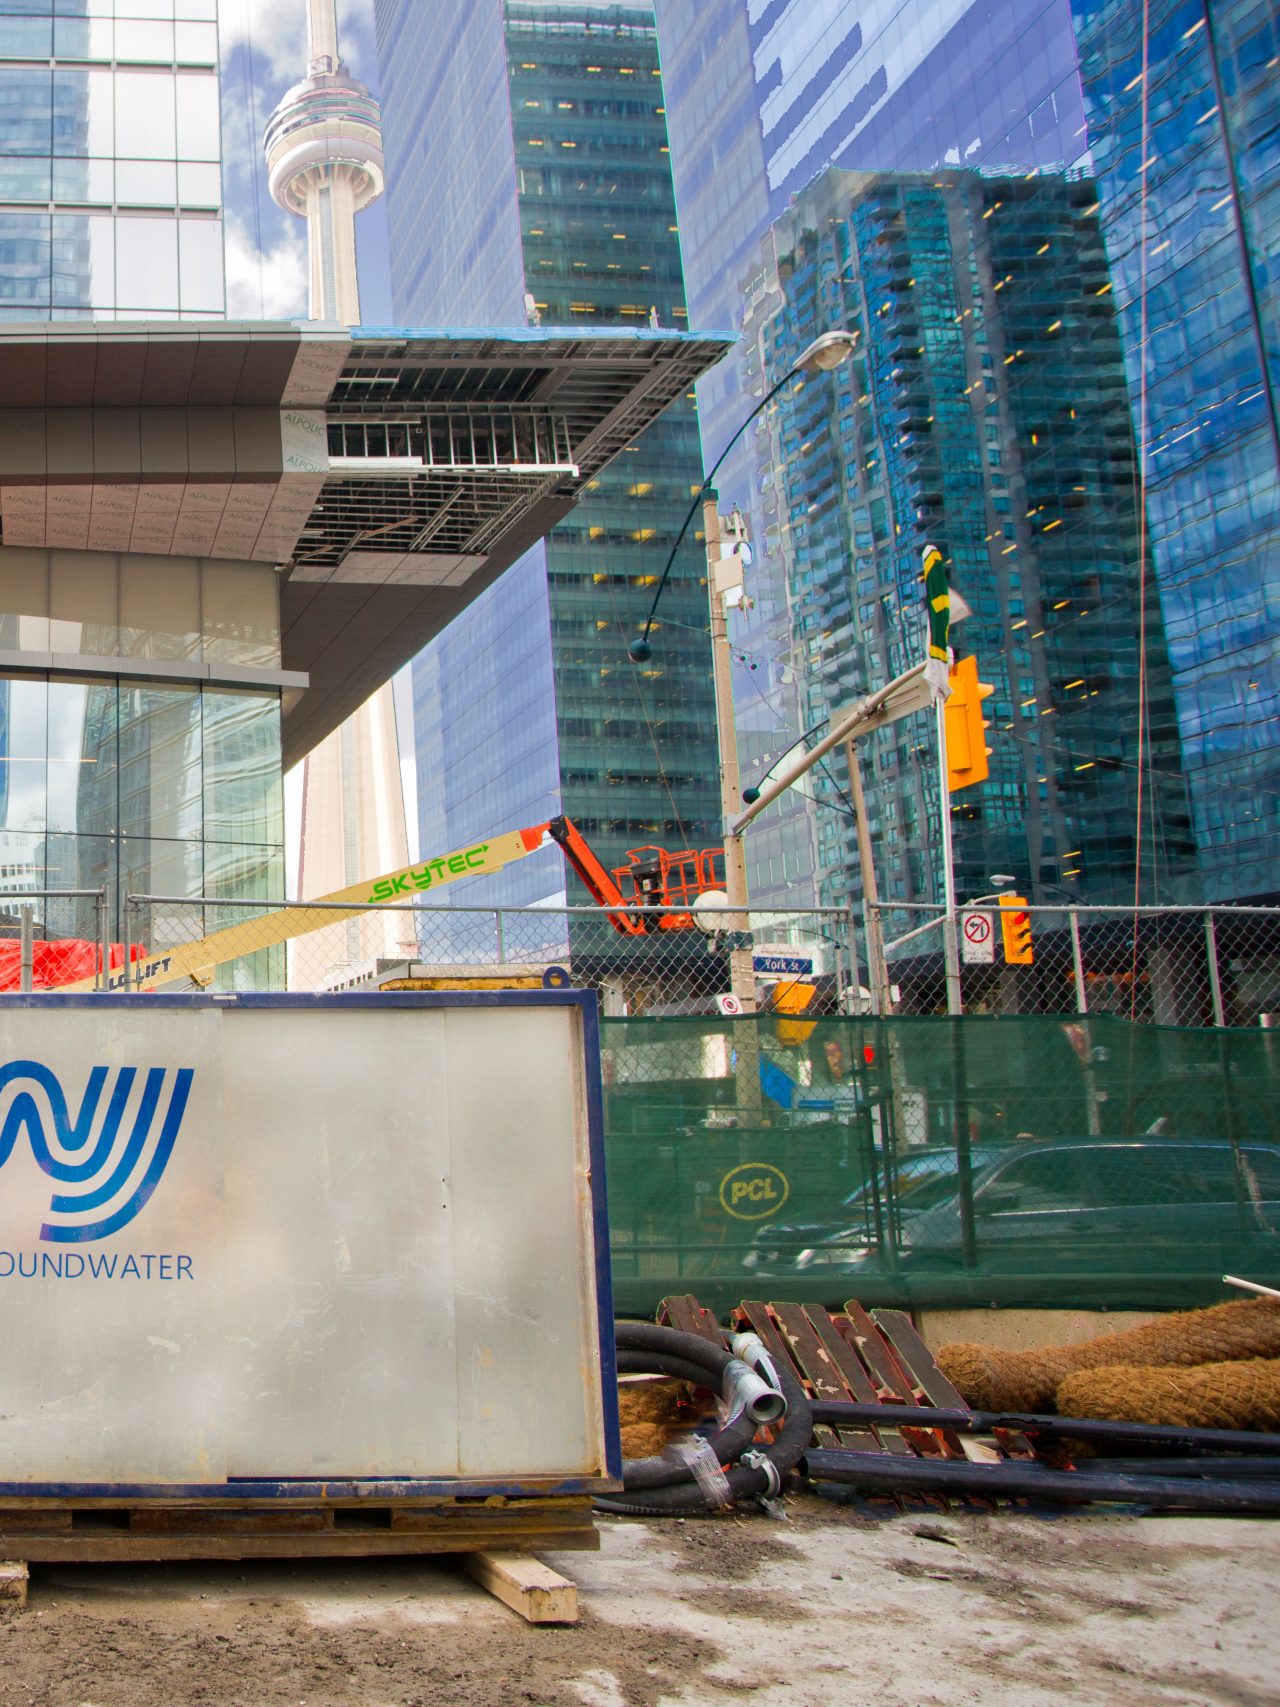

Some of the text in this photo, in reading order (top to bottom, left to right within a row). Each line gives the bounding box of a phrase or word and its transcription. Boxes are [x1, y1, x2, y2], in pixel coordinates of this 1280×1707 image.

[284, 413, 325, 436] ALPOLIC
[371, 847, 487, 902] SKYTEC
[765, 959, 786, 970] York
[731, 1177, 777, 1205] PCL
